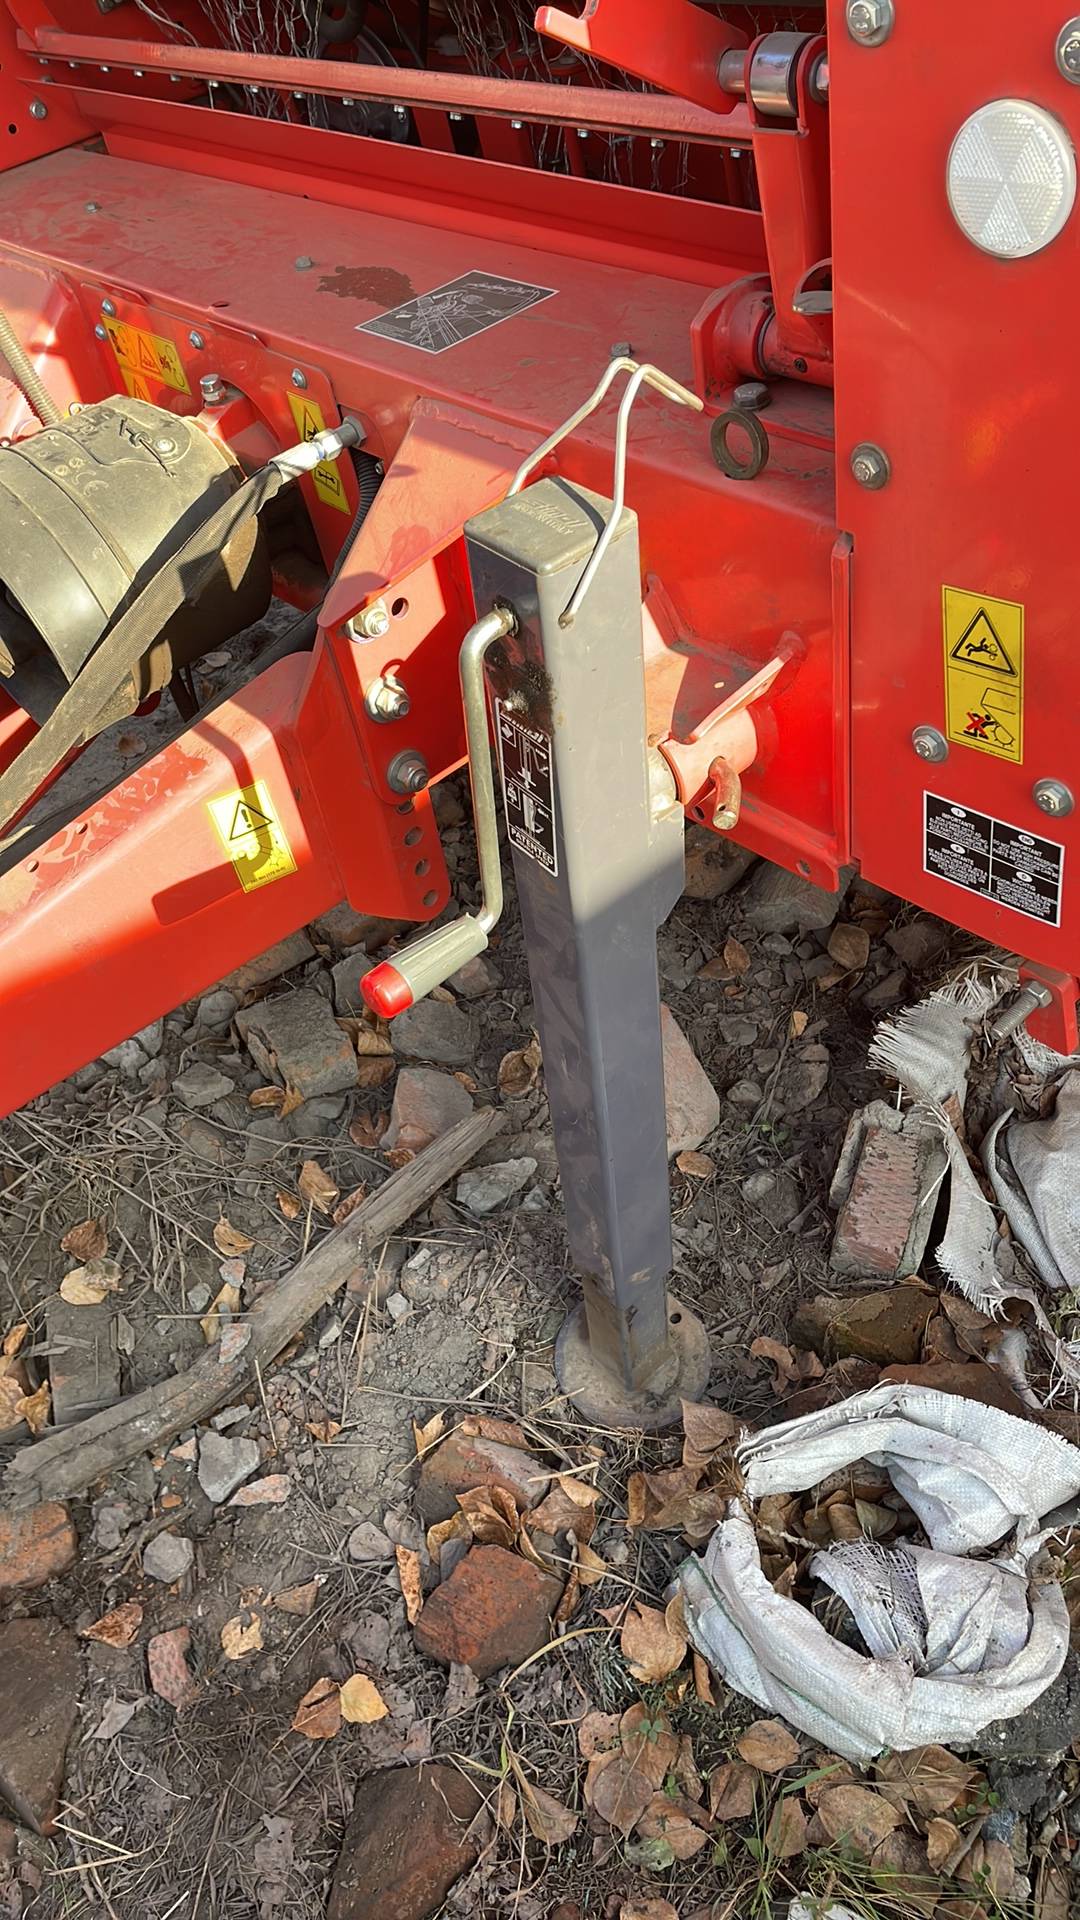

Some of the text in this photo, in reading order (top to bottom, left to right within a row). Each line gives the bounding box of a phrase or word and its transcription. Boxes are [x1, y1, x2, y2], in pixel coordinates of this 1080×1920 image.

[941, 811, 975, 830] IMPORTANTE
[510, 826, 554, 865] PATENTED
[1009, 839, 1042, 857] IMPORTANT
